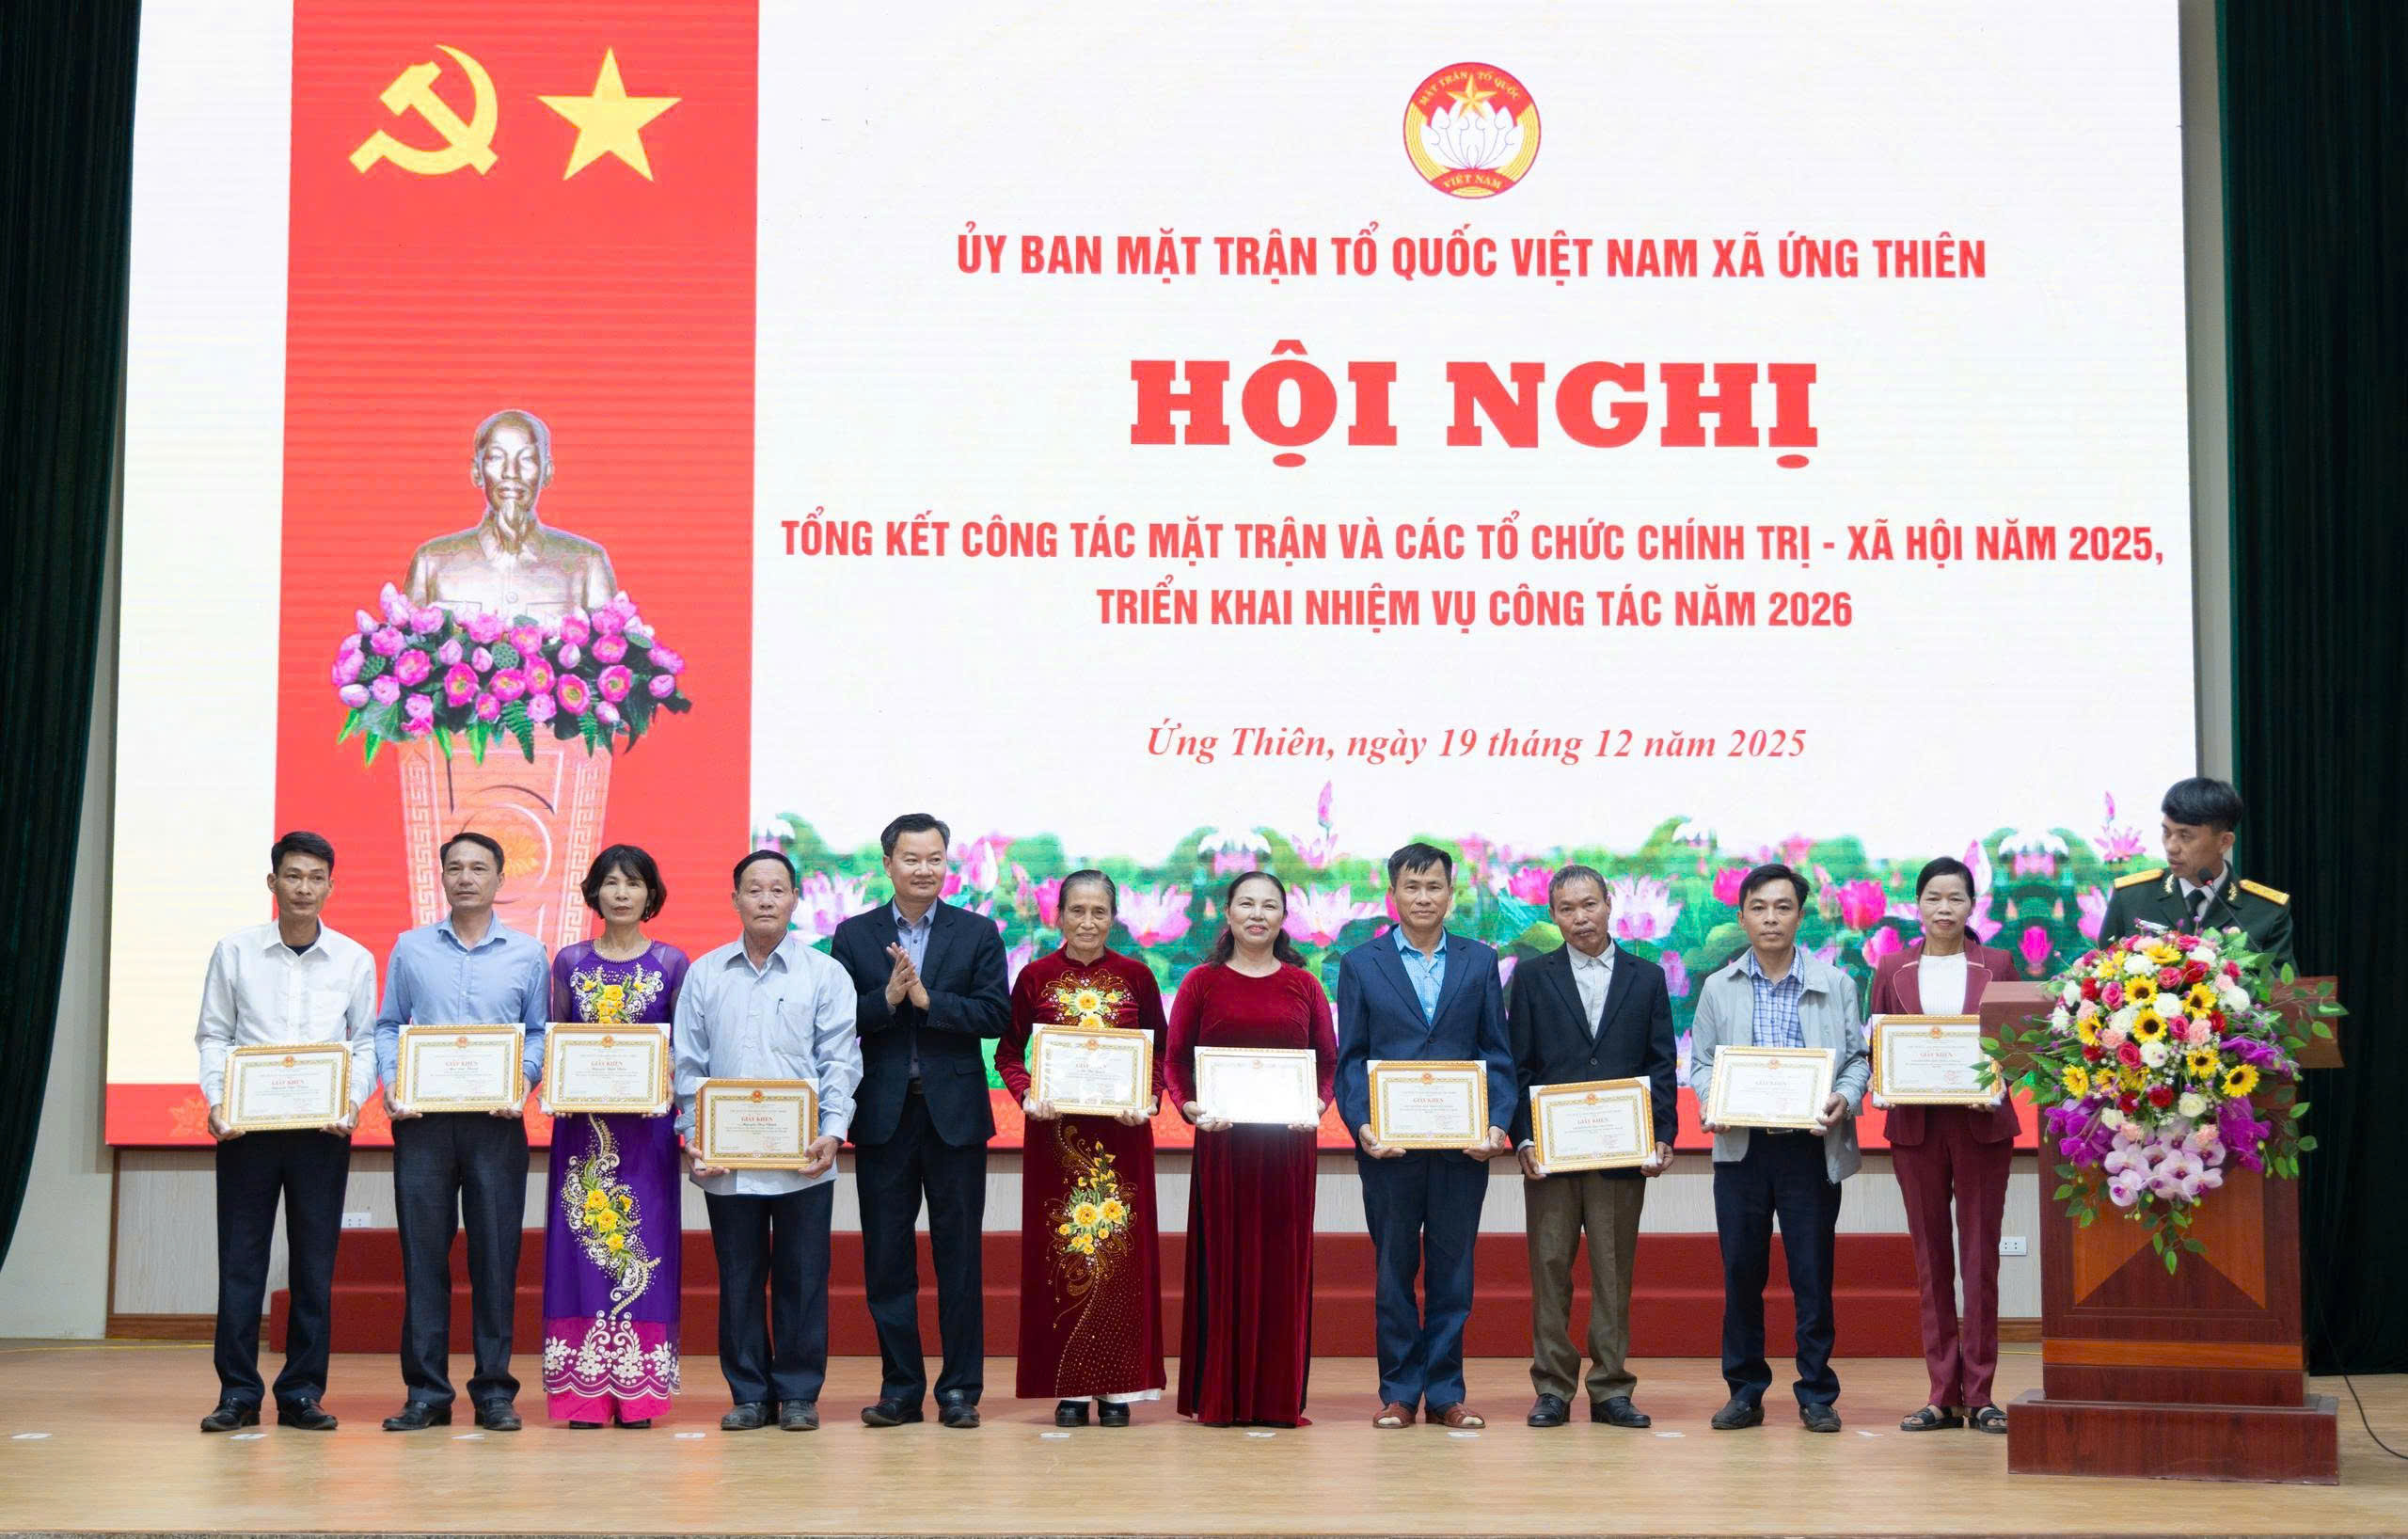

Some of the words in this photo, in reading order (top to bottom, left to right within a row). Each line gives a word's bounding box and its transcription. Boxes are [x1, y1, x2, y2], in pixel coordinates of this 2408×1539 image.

[1475, 174, 1502, 189] NAM
[958, 221, 1006, 274] ỦY
[1022, 235, 1101, 274] BAN
[1117, 228, 1201, 284] MẶT
[1213, 229, 1317, 284] TRẬN
[1331, 221, 1379, 277] TỔ
[1392, 224, 1497, 281] QUỐC
[1512, 230, 1592, 286] VIỆT
[1608, 238, 1697, 277] NAM
[1712, 231, 1765, 278] XÃ
[1778, 230, 1859, 278] ỨNG
[1872, 231, 1987, 278] THIÊN
[1131, 340, 1397, 468] HỘI
[1447, 360, 1818, 468] NGHỊ
[782, 506, 873, 557] TỔNG
[887, 511, 949, 557] KẾT
[962, 515, 1057, 557] CÔNG
[1070, 516, 1135, 557] TÁC
[1149, 516, 1223, 566] MẶT
[1235, 516, 1326, 566] TRẬN
[1339, 517, 1383, 560] VÀ
[1396, 517, 1465, 560] CÁC
[1477, 511, 1520, 560] TỔ
[1532, 517, 1624, 561] CHỨC
[1638, 517, 1744, 561] CHÍNH
[1757, 526, 1810, 568] TRỊ
[1847, 518, 1893, 561] XÃ
[1907, 518, 1962, 568] HỘI
[1976, 518, 2056, 561] NĂM
[2069, 526, 2163, 564] 2025,
[1097, 574, 1197, 625] TRIỂN
[1212, 590, 1292, 625] KHAI
[1307, 582, 1419, 633] NHIỆM
[1432, 591, 1476, 633] VỤ
[1489, 583, 1584, 627] CÔNG
[1597, 584, 1662, 627] TÁC
[1675, 584, 1756, 627] NĂM
[1768, 592, 1853, 627] 2026
[1148, 719, 1218, 764] Ứng
[1232, 727, 1334, 760] Thiên,
[1347, 730, 1427, 764] ngày
[1440, 729, 1478, 757] 19
[1489, 728, 1582, 764] tháng
[1596, 730, 1633, 757] 12
[1644, 732, 1716, 757] năm
[1728, 730, 1807, 757] 2025
